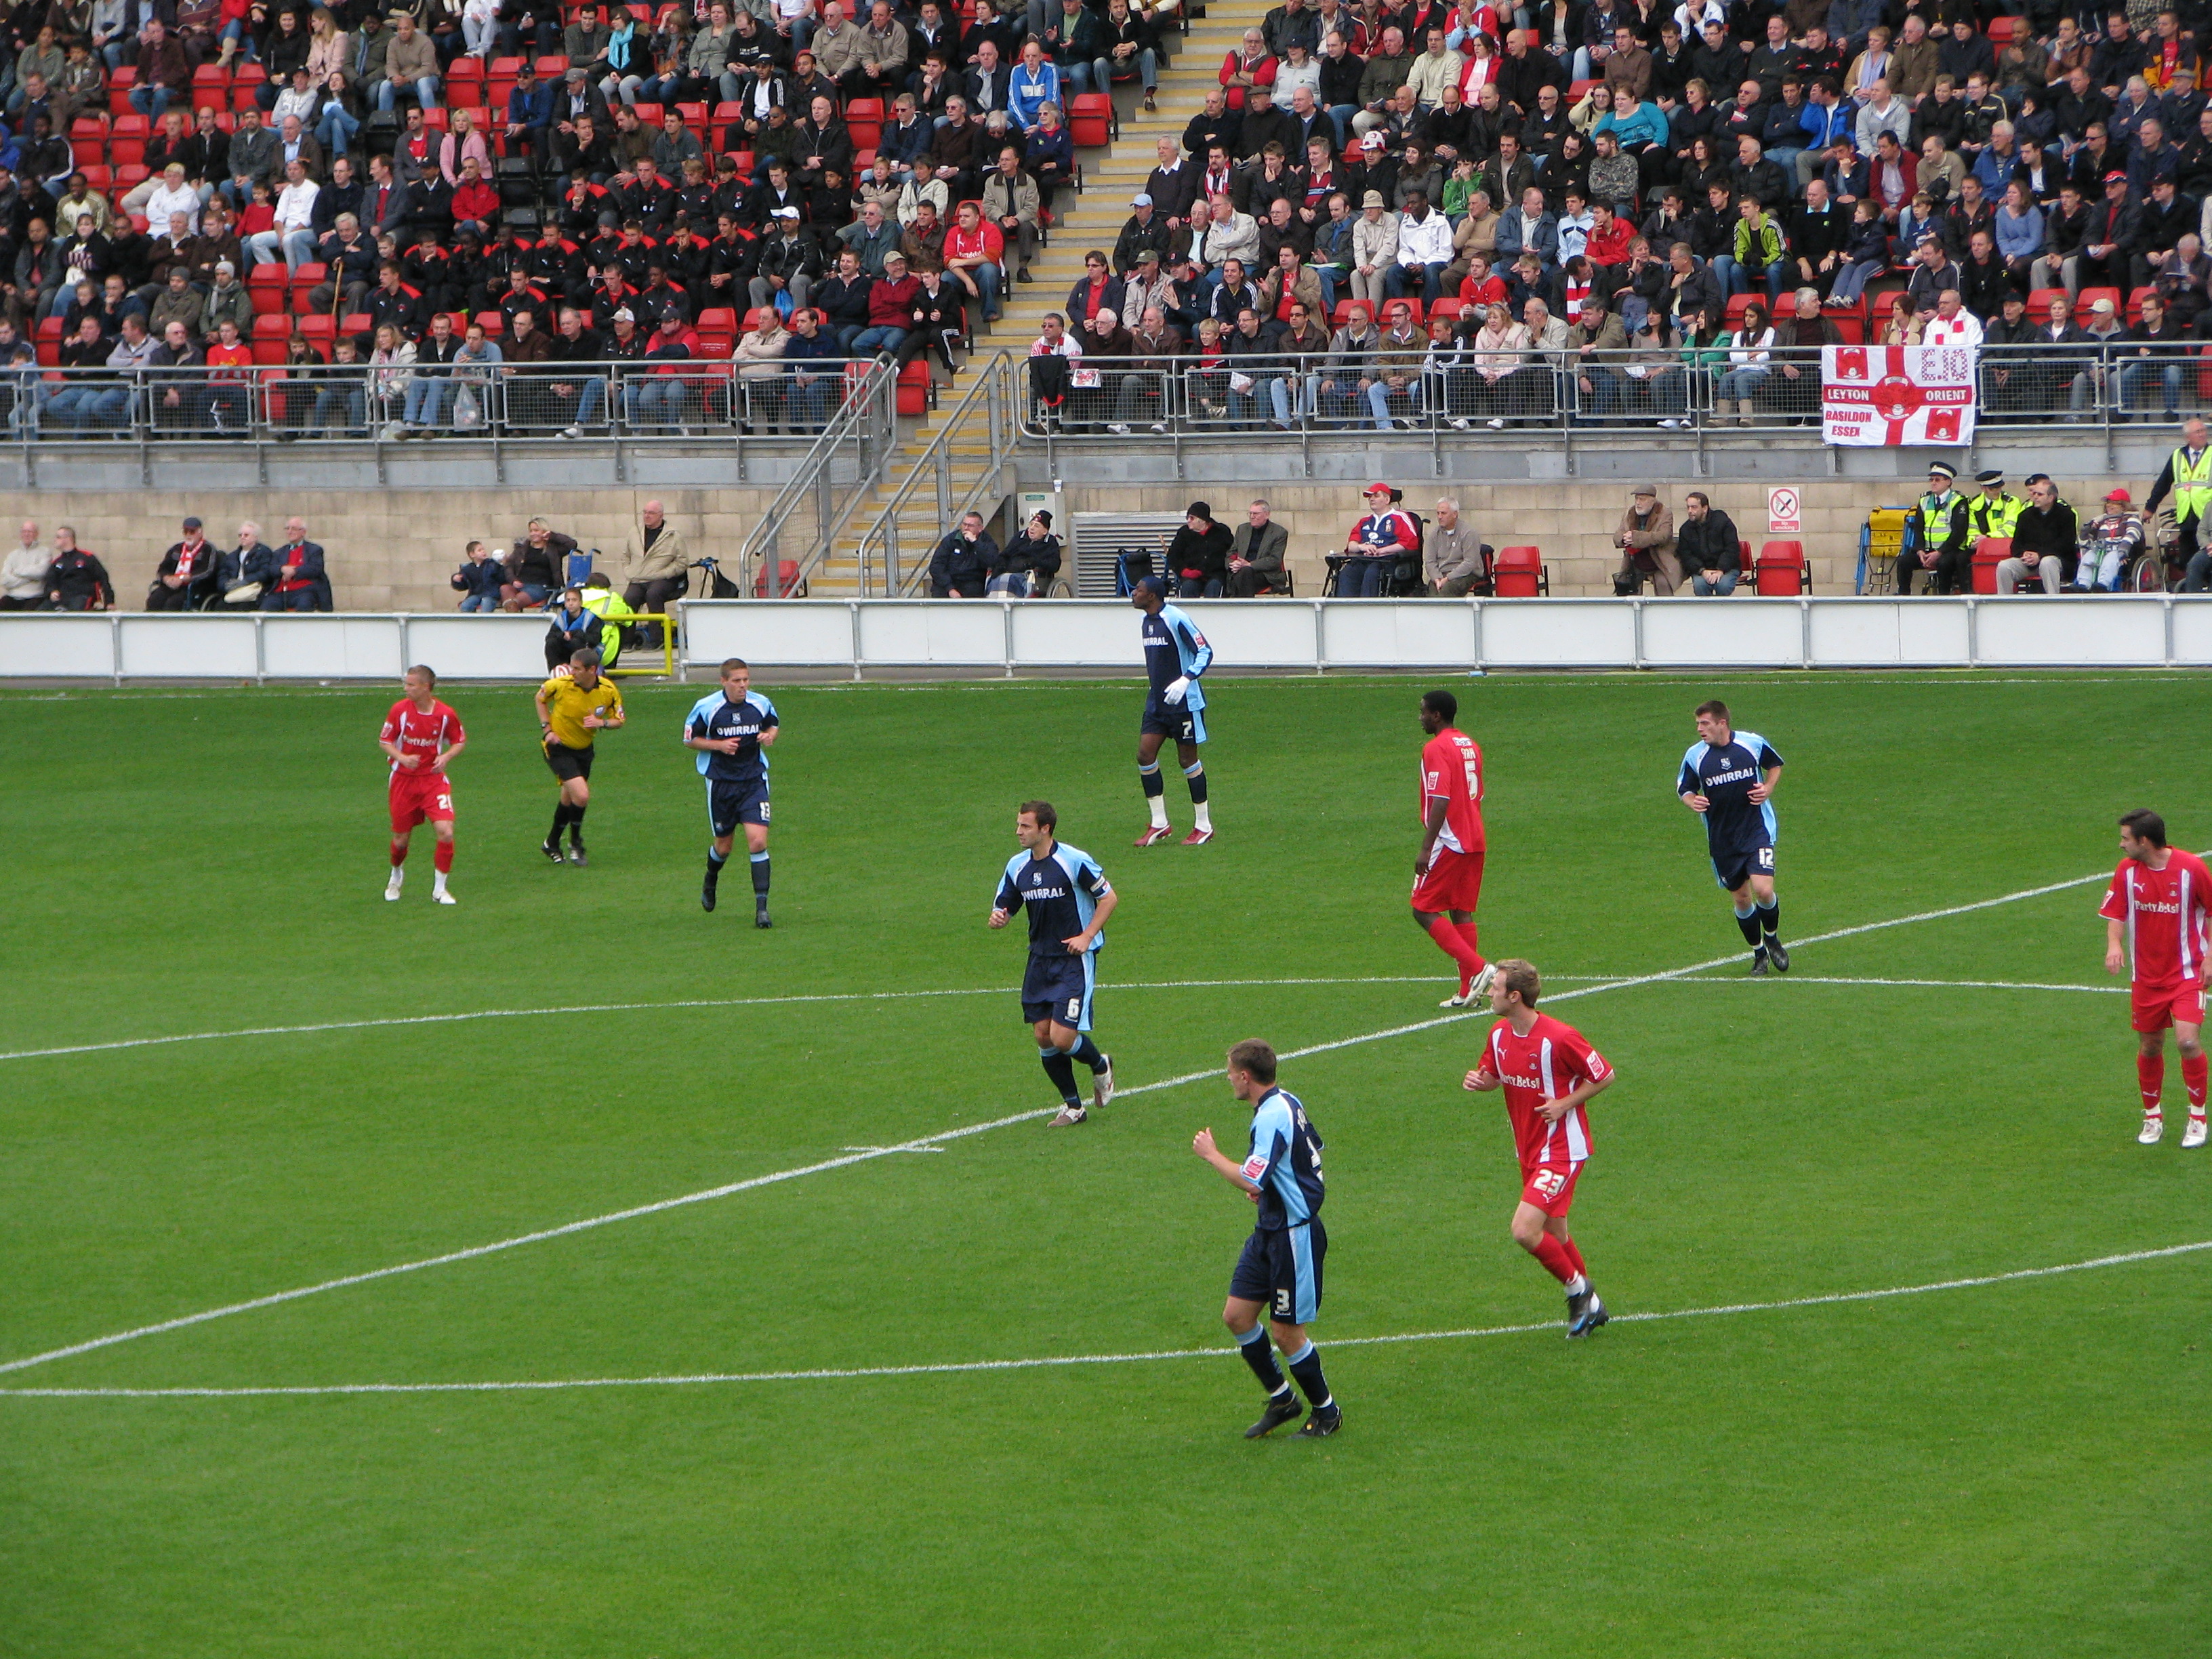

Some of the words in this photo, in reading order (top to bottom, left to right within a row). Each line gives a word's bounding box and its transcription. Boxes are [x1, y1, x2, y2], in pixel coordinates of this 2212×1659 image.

[1828, 388, 1869, 401] LEYTON
[1926, 389, 1967, 401] ORIENT
[1825, 410, 1872, 422] BASILDON
[1832, 425, 1860, 437] ESSEX
[1182, 720, 1192, 736] 7
[1464, 760, 1478, 800] 5
[1712, 766, 1755, 786] WIRRAL
[760, 802, 771, 819] 13
[1759, 848, 1774, 866] 12
[1025, 887, 1066, 901] WIRRAL
[1067, 998, 1080, 1019] 6
[1533, 1169, 1565, 1196] 23
[1276, 1288, 1290, 1312] 3
